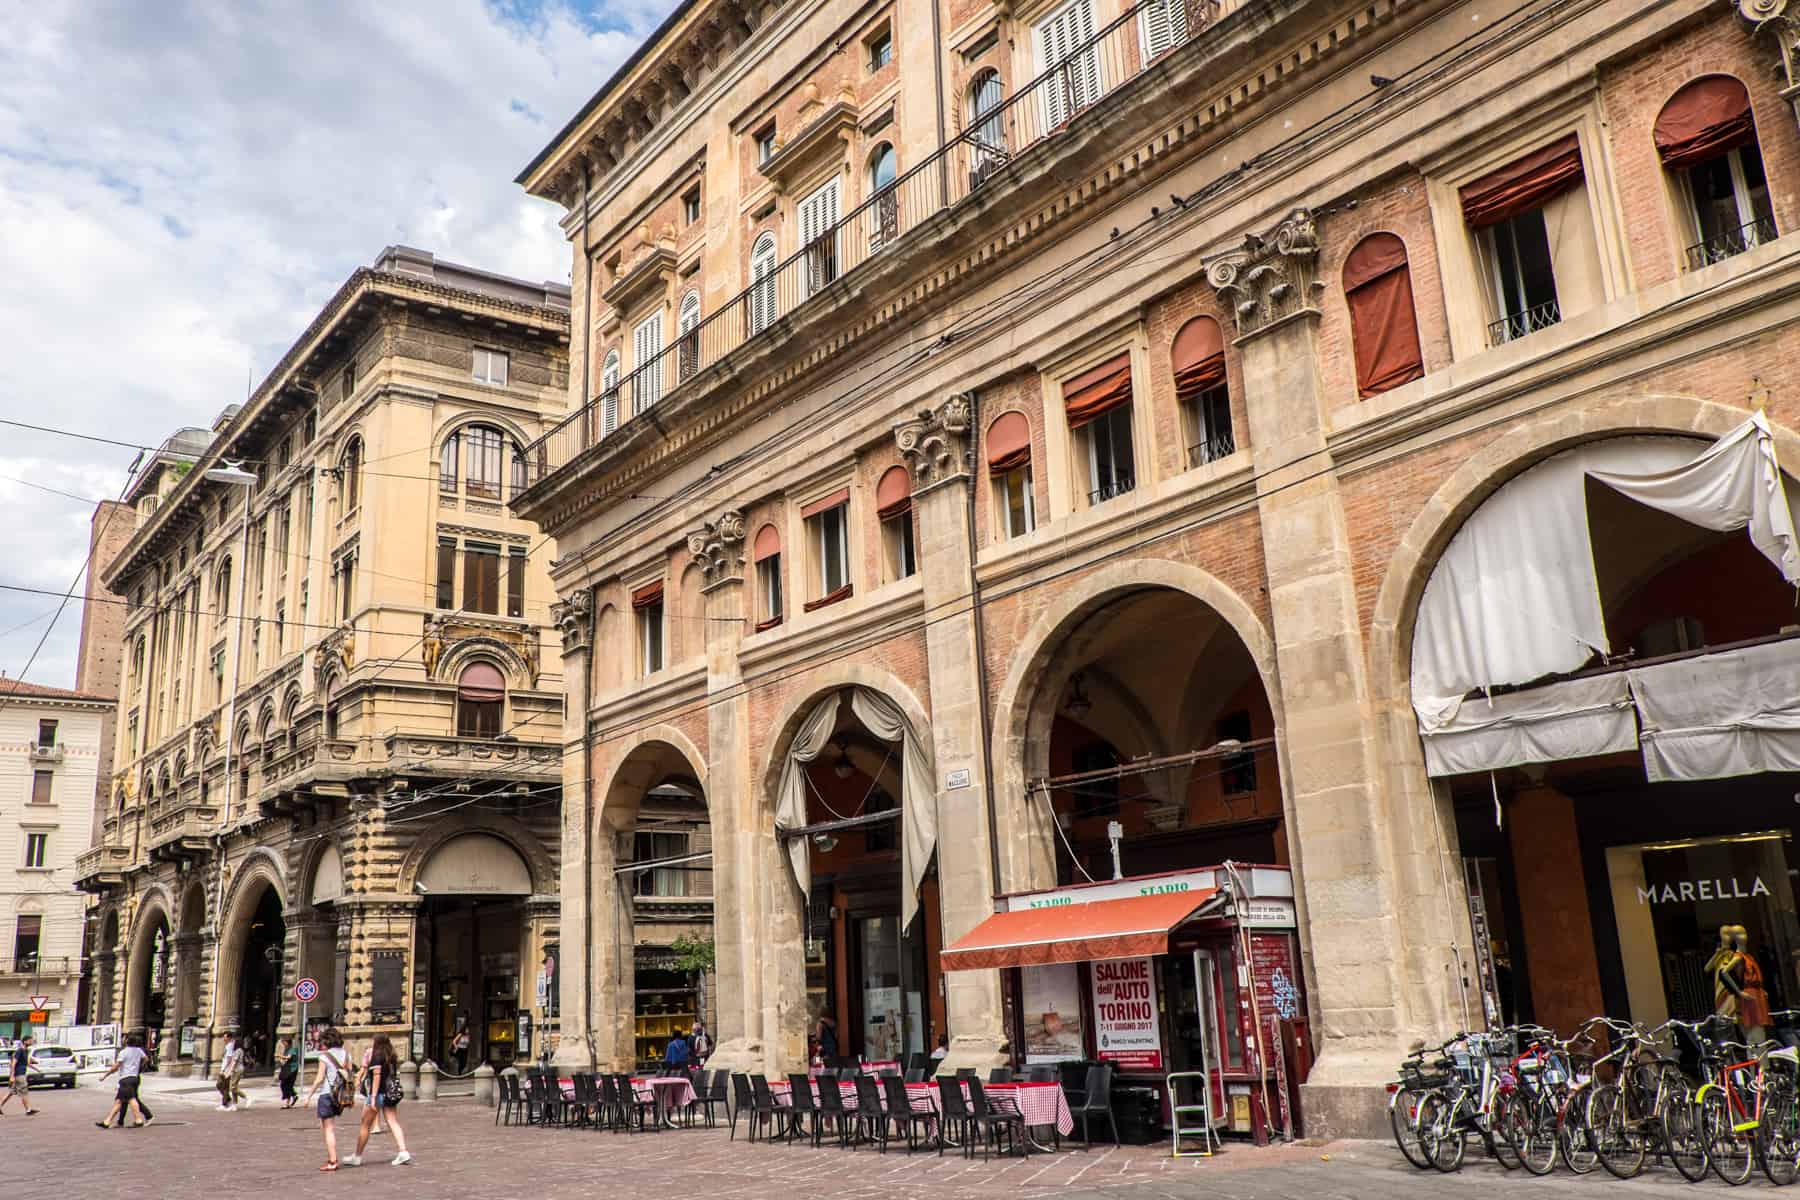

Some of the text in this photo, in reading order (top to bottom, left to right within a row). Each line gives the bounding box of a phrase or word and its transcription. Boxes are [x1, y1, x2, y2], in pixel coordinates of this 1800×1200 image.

[1140, 882, 1189, 897] STADIO
[1637, 875, 1771, 904] MARELLA
[1030, 896, 1072, 908] STADIO
[1096, 960, 1148, 981] SALONE
[1114, 981, 1150, 1000] AUTO
[1098, 1001, 1152, 1021] TORINO
[1137, 1021, 1153, 1030] 2017
